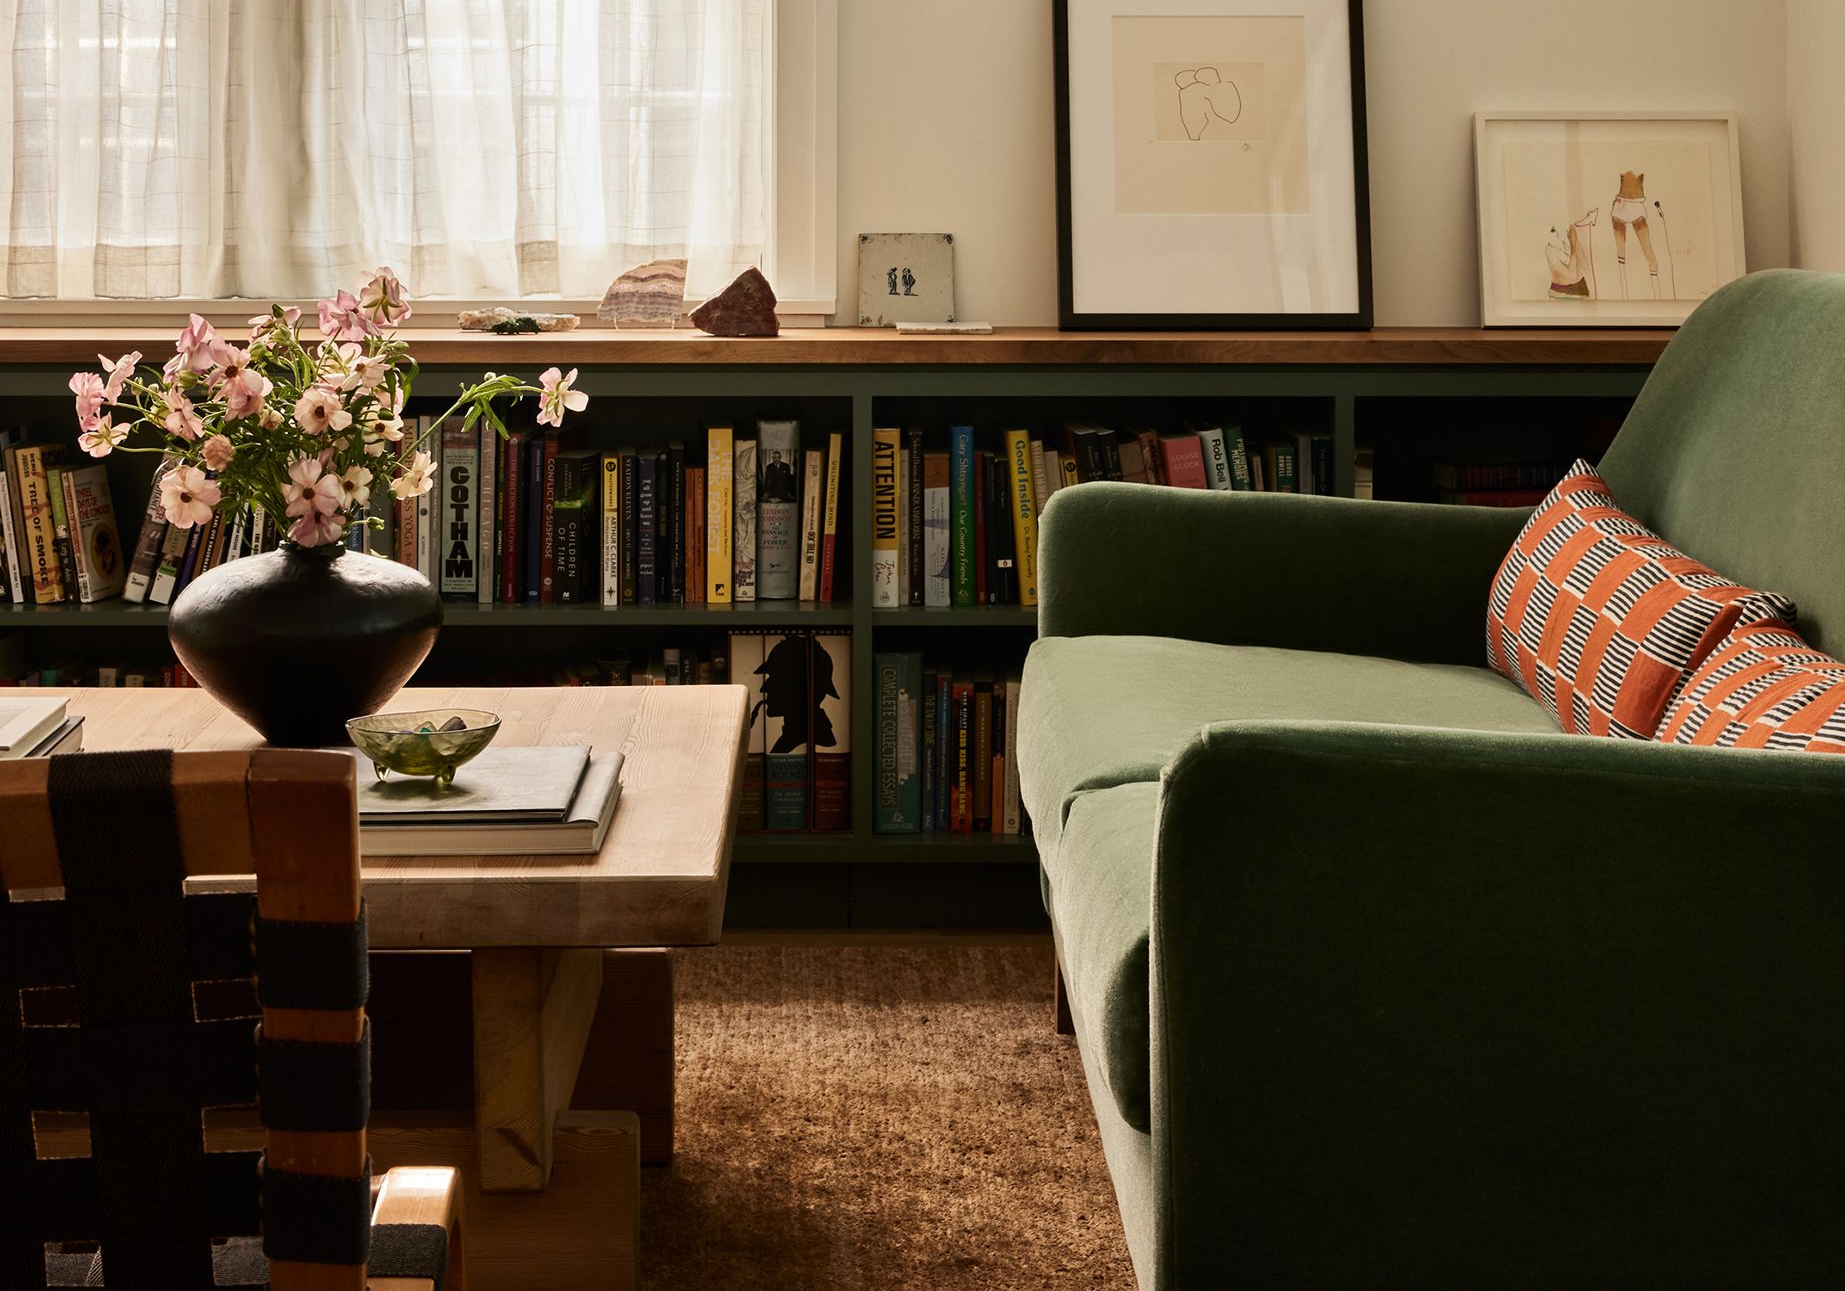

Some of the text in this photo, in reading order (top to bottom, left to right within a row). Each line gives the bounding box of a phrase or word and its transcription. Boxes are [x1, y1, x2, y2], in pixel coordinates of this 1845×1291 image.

[958, 434, 968, 455] Gary
[1016, 440, 1028, 474] Good
[1171, 452, 1199, 462] LOUISE
[29, 453, 37, 476] DENIS
[625, 458, 633, 490] STATION
[721, 452, 733, 481] THE
[1212, 439, 1226, 483] Rob Bell
[1231, 449, 1242, 481] MEMOIRS
[1236, 438, 1250, 484] POSTHUMOUS
[75, 487, 92, 498] THREE
[546, 458, 555, 501] CONFLICT
[875, 441, 896, 539] ATTENTION
[77, 497, 91, 509] DAYS
[89, 504, 111, 517] CONDOR
[482, 475, 491, 550] CHICAGO
[624, 491, 632, 521] ELEVEN
[708, 439, 720, 555] DARK FOREST
[1018, 478, 1031, 519] Inside
[28, 482, 48, 586] TREE OF SMOKE
[405, 515, 414, 547] YOGA
[445, 466, 473, 578] GOTHAM
[544, 515, 554, 559] SUSPENSE
[557, 527, 566, 572] OF TIME
[568, 522, 577, 578] CHILDREN
[807, 543, 815, 555] THE
[807, 556, 814, 564] ON
[957, 509, 968, 585] Our Country Friends
[1024, 537, 1032, 553] Becky
[1025, 554, 1034, 578] Kennedy
[882, 668, 897, 806] COMPLETE COLLECTED ESSAYS
[959, 729, 967, 747] KISS
[958, 749, 967, 771] KISS,
